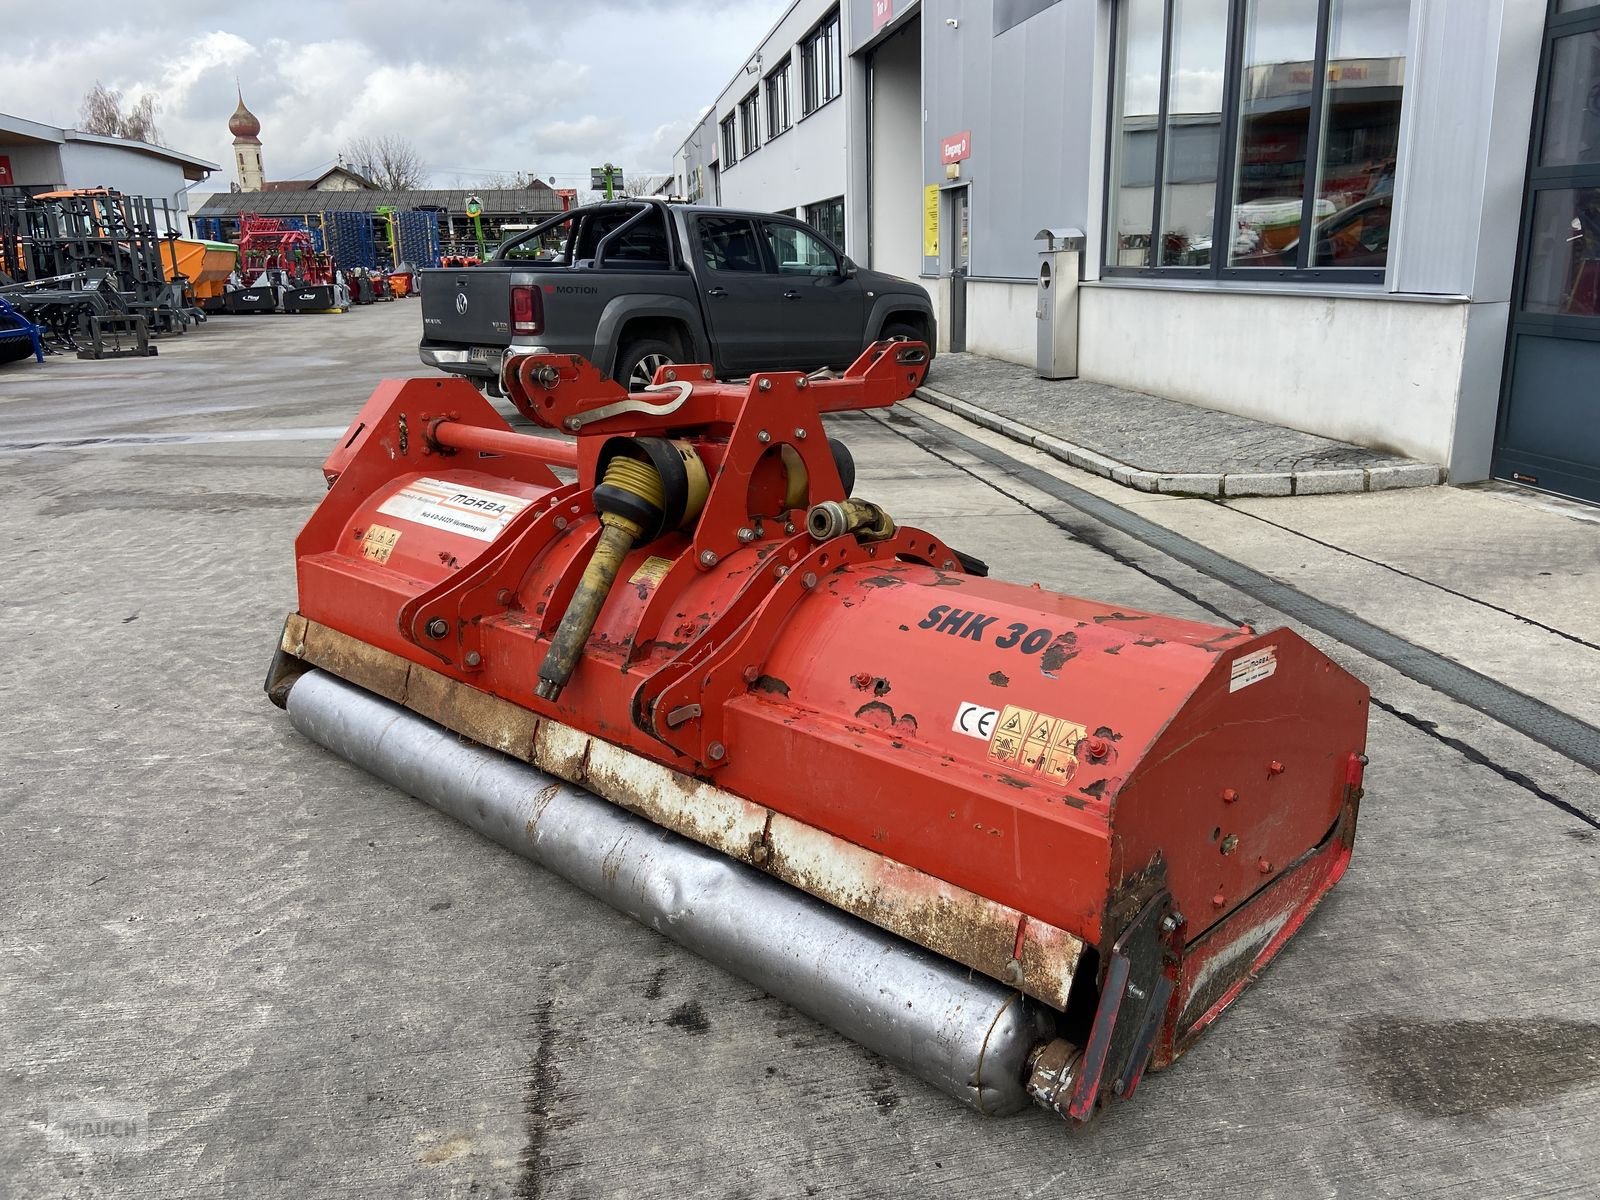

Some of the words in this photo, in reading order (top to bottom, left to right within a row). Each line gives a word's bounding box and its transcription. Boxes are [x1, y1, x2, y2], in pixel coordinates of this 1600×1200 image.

[945, 142, 961, 157] Eingang
[961, 139, 966, 152] D
[556, 285, 598, 295] MOTION
[918, 605, 999, 641] SHK
[960, 707, 995, 737] CE
